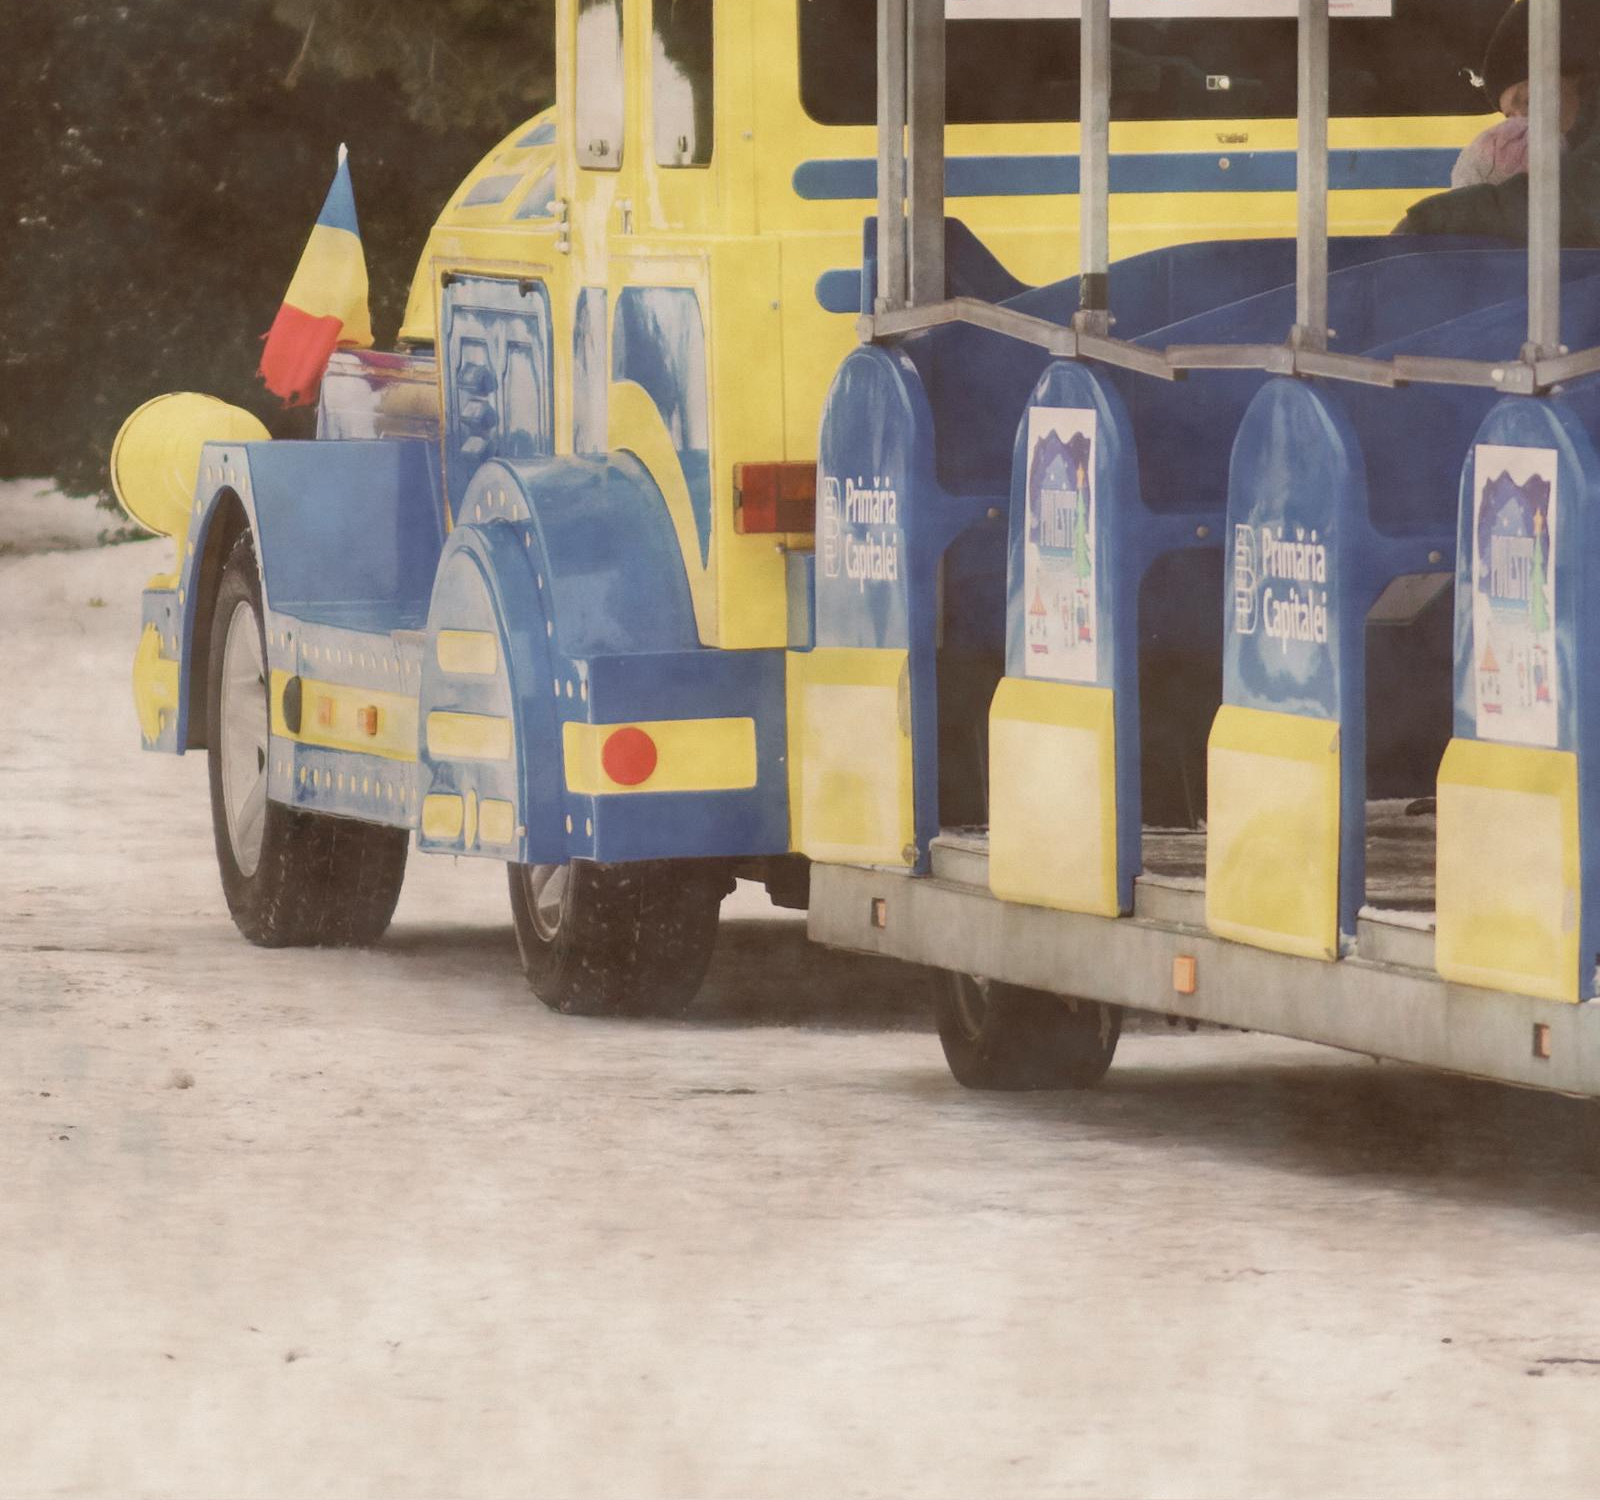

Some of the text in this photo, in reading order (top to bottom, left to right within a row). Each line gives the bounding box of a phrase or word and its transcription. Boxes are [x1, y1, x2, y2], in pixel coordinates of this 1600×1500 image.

[845, 475, 897, 524] Primăria
[845, 531, 898, 593] Capitalei
[1262, 526, 1326, 583] Primăria
[1262, 587, 1328, 655] Capitalei
